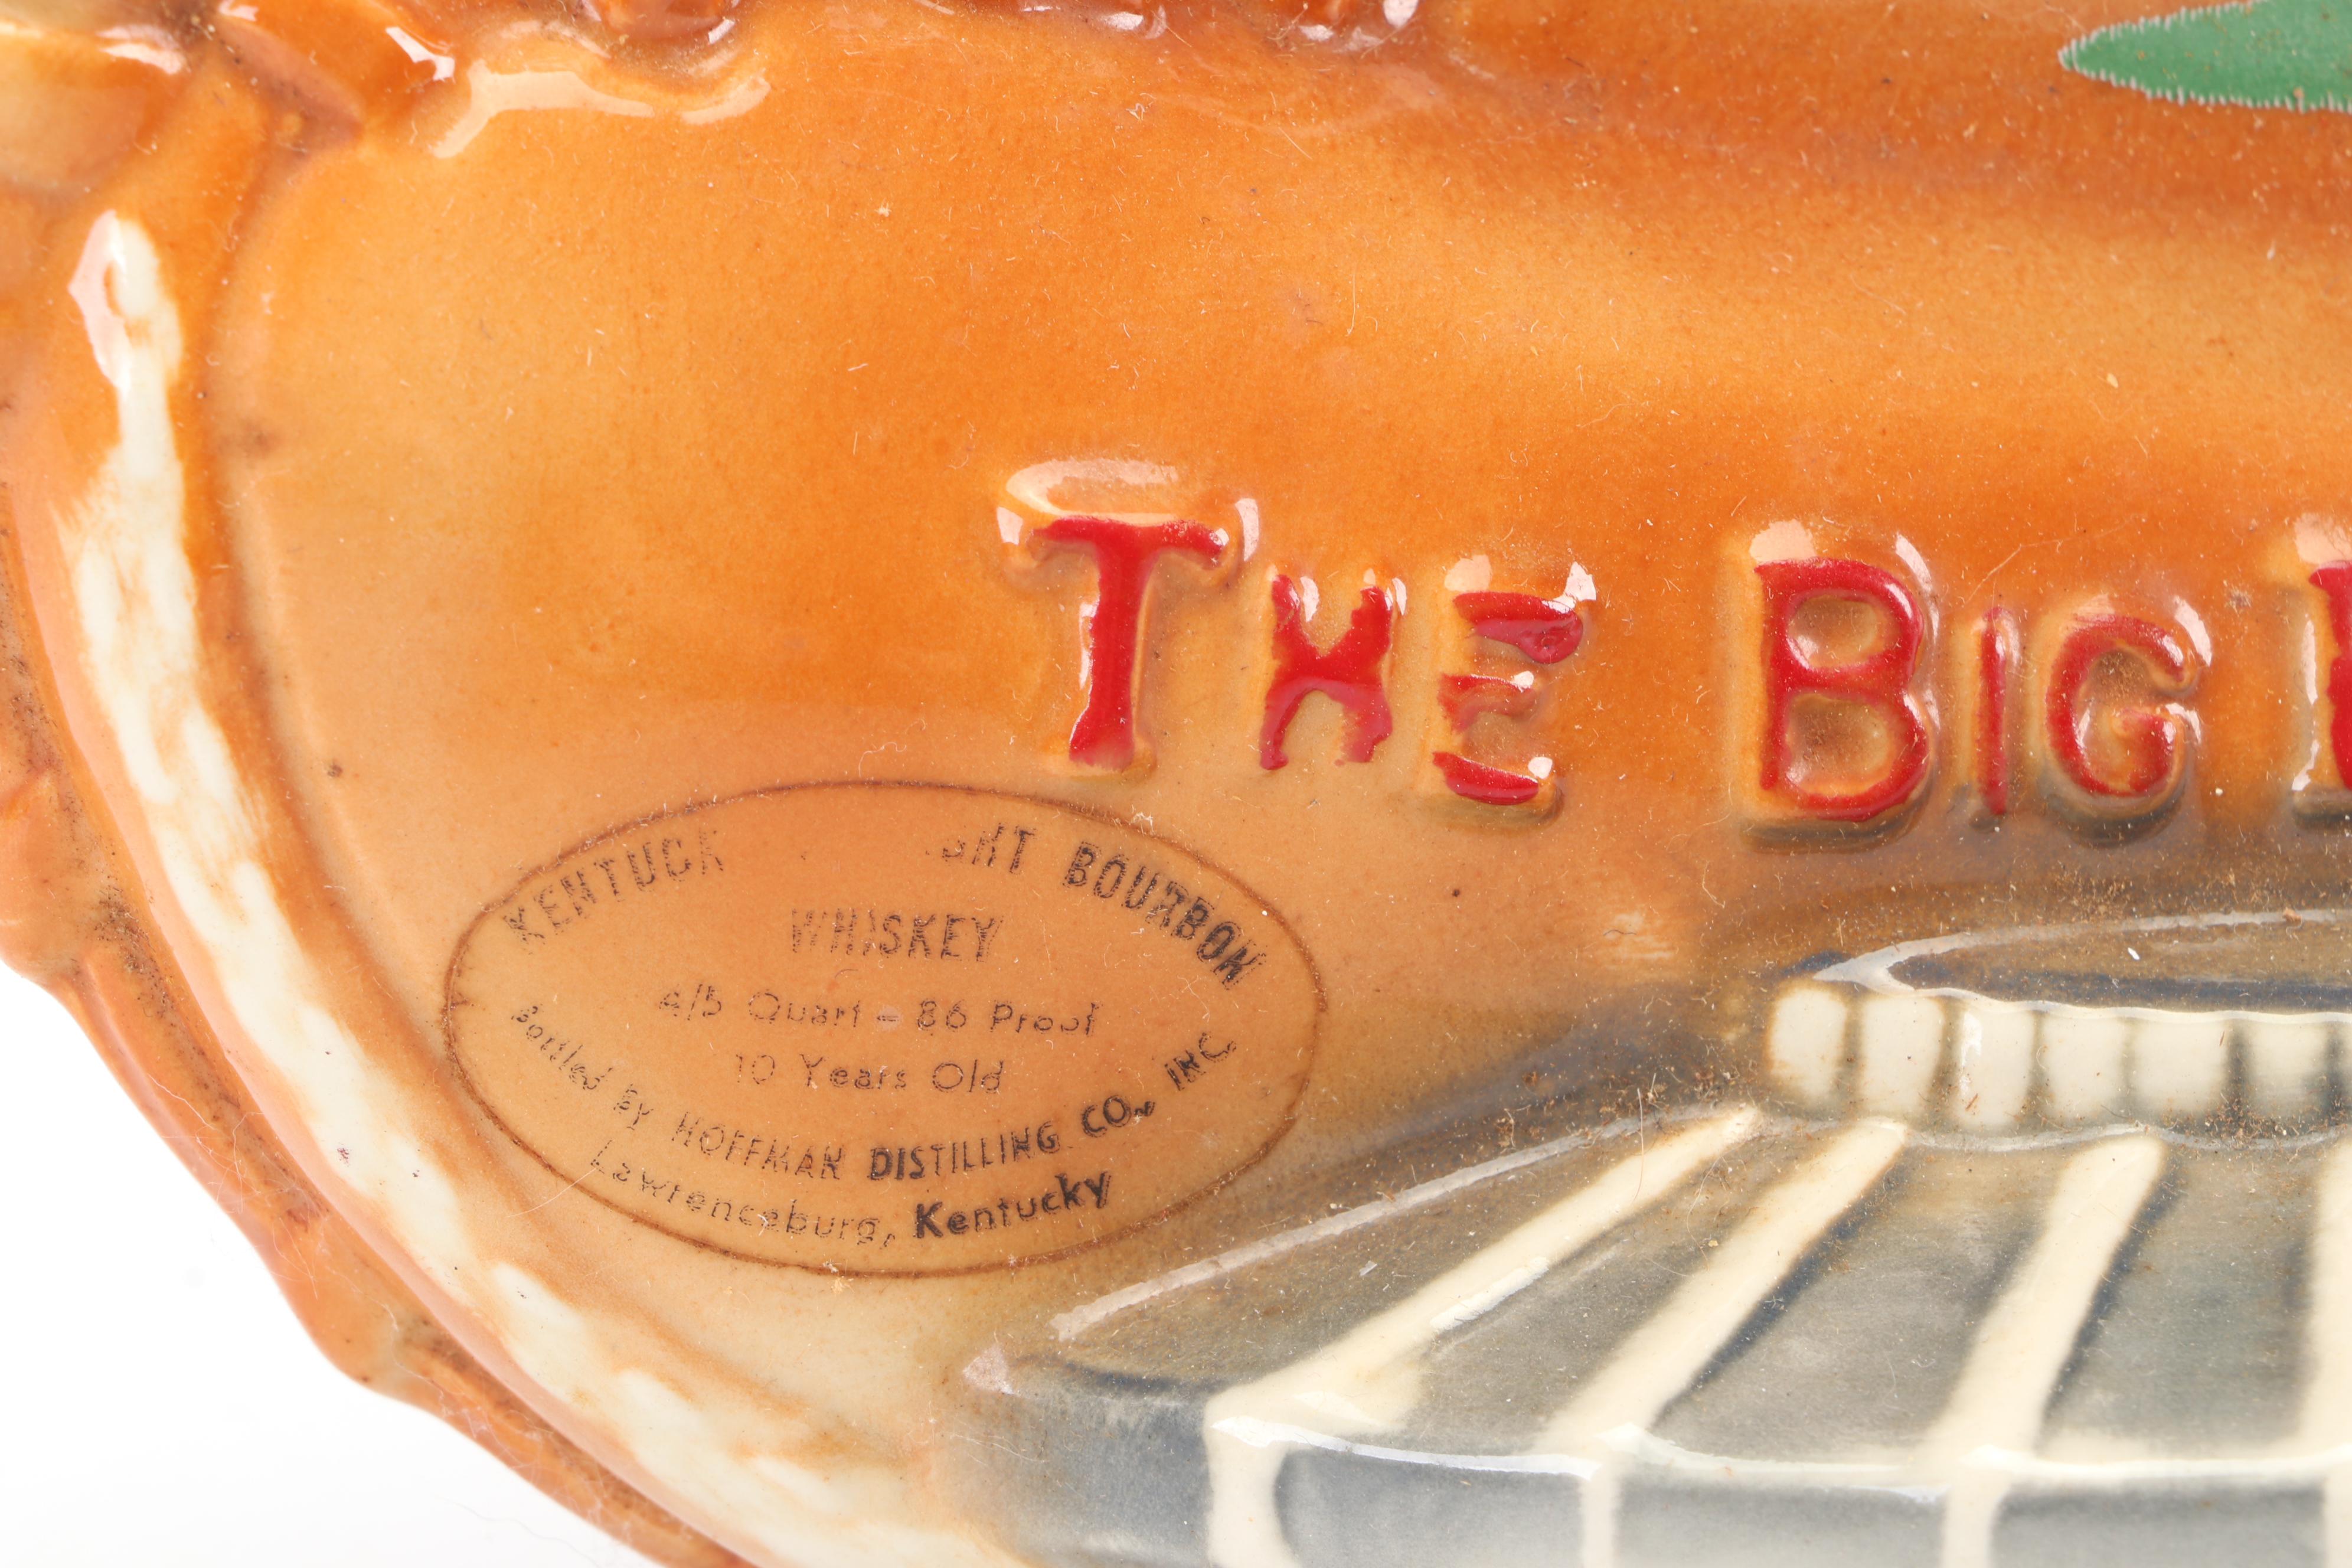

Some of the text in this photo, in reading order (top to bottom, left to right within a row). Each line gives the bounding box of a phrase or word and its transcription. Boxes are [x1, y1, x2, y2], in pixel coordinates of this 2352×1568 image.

[1026, 511, 1585, 808] THE
[1753, 555, 2184, 822] BIG
[791, 907, 1004, 962] WHISKEY
[1063, 841, 1268, 990] BOURBON
[747, 988, 861, 1028] Quart
[917, 998, 967, 1030] 86
[989, 999, 1103, 1037] Proof
[736, 1053, 1005, 1093] 10 Years Old
[672, 1111, 845, 1181] HOFFMAN
[869, 1121, 1060, 1181] DISTILLING
[914, 1170, 1113, 1240] Kentucky
